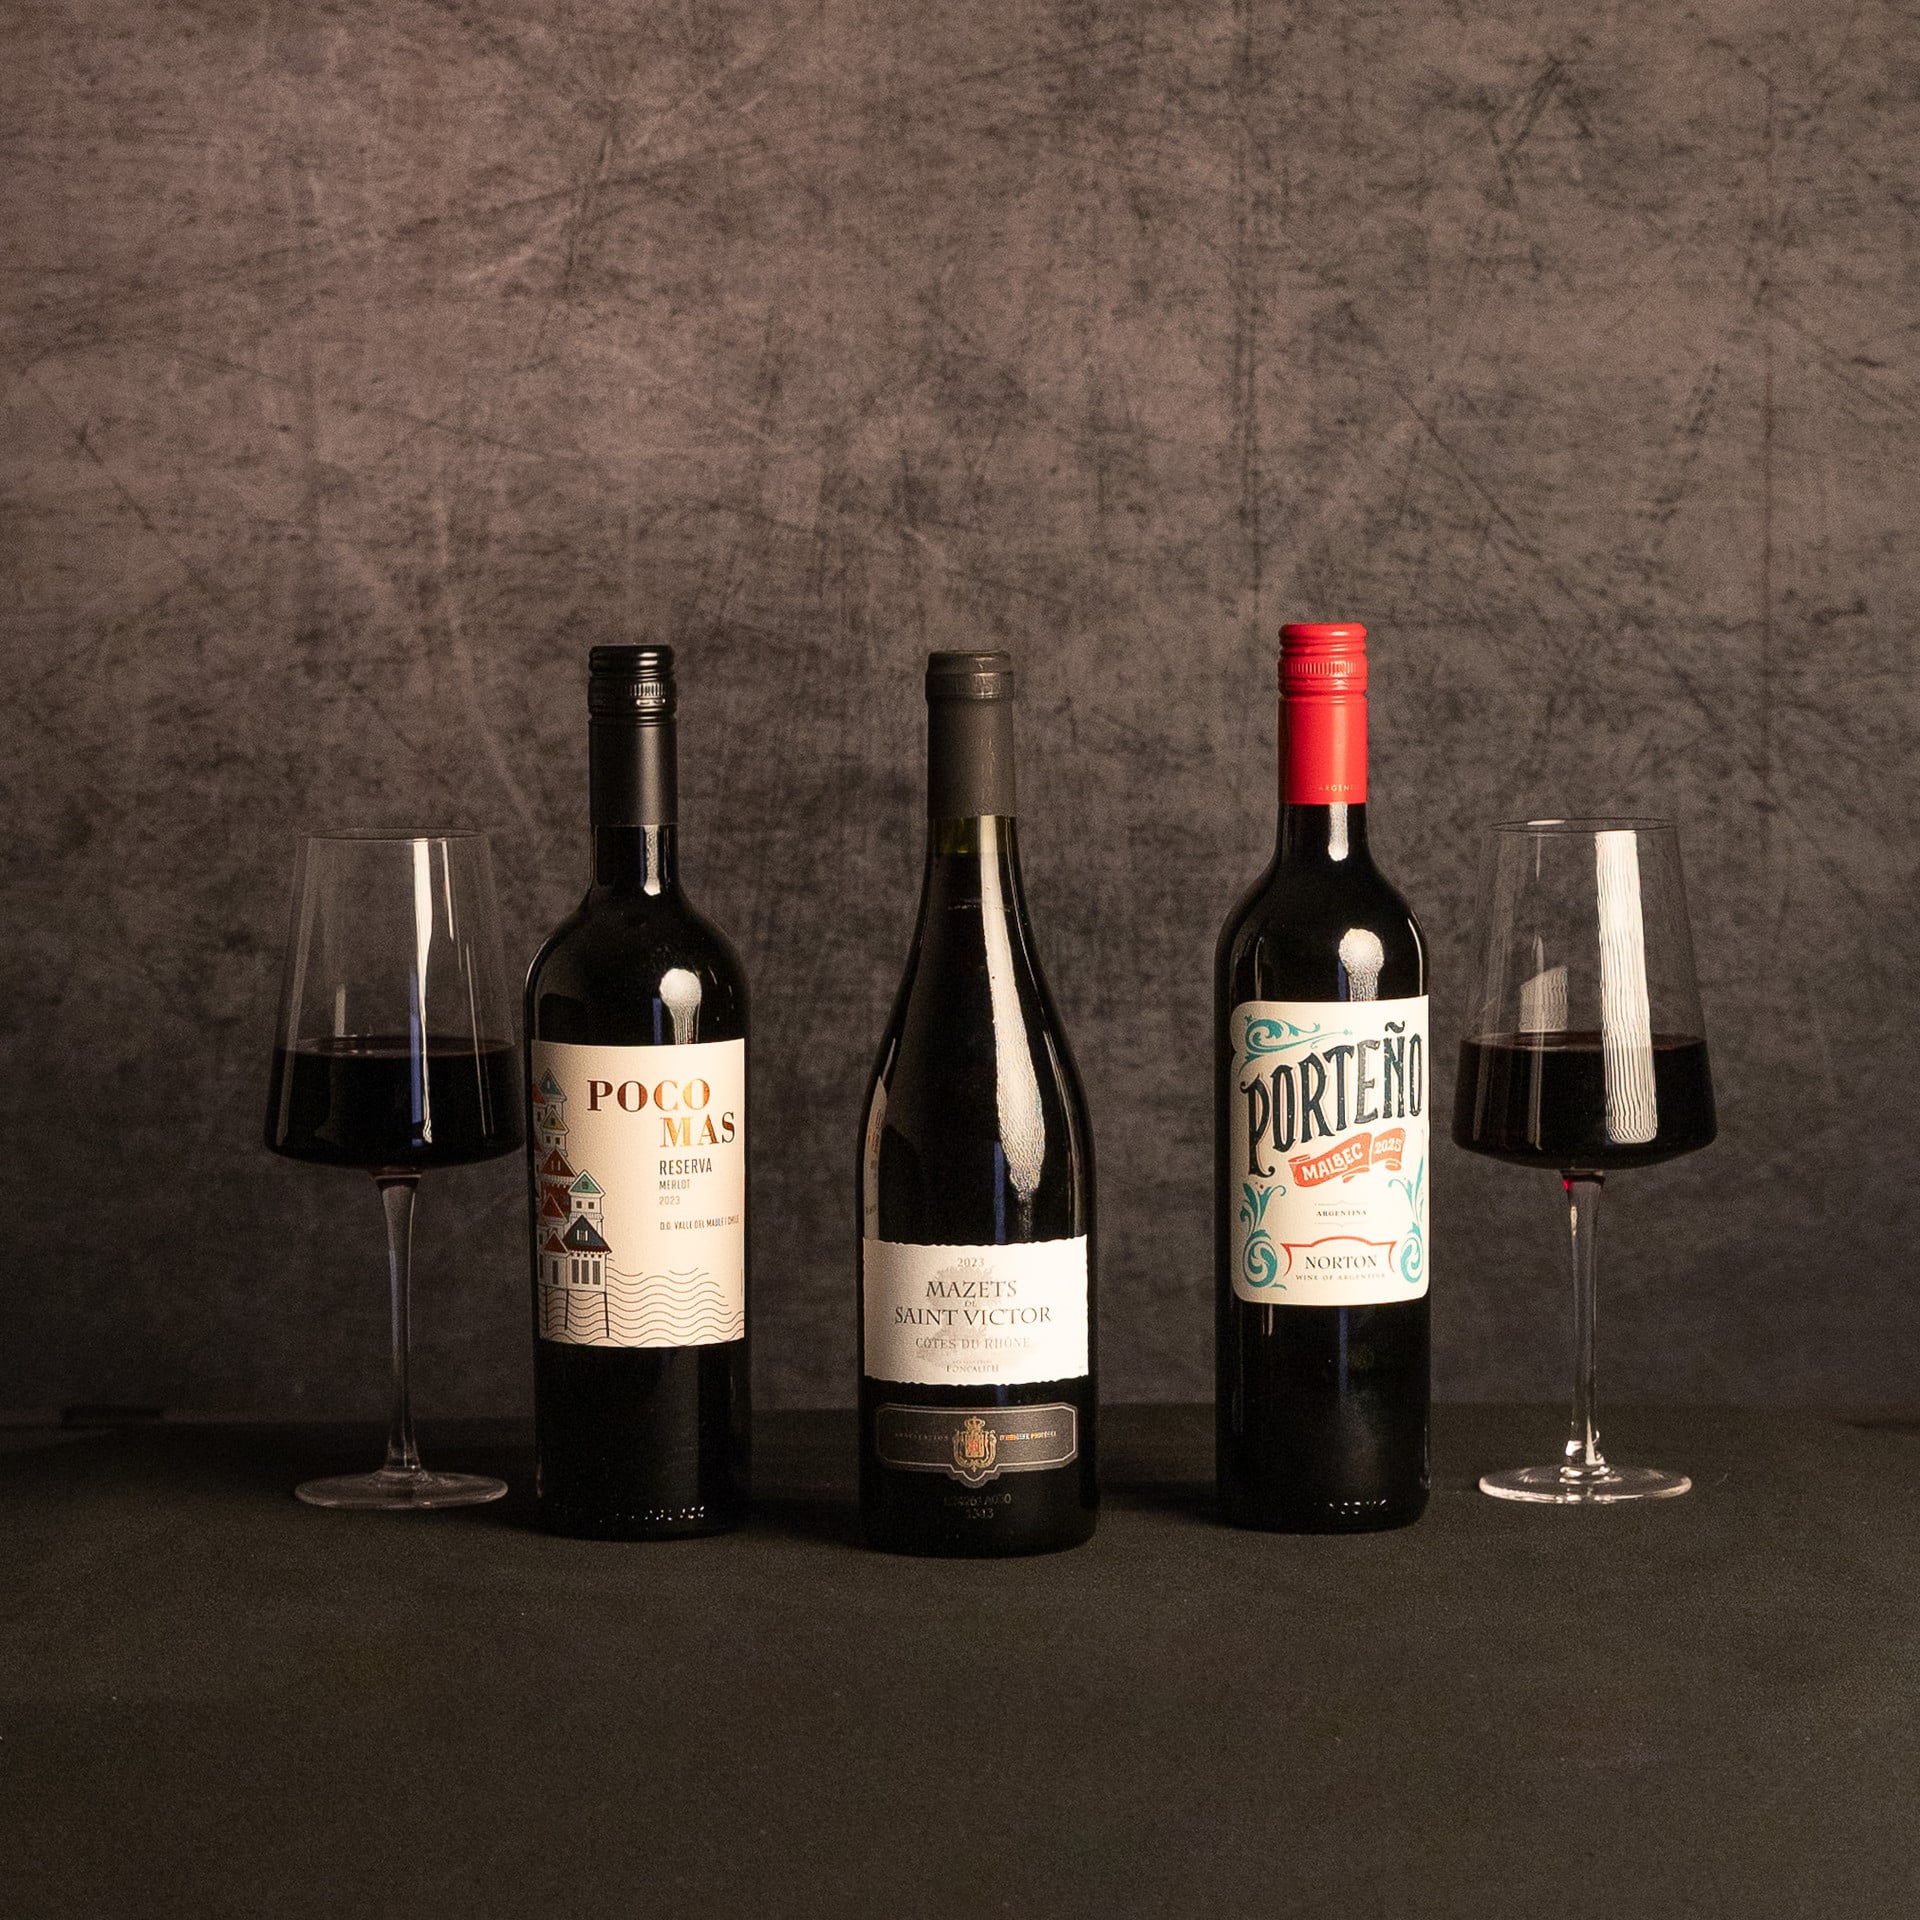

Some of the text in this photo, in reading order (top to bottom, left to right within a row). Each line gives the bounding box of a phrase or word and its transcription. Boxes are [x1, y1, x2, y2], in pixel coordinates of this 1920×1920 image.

[587, 1078, 711, 1113] POCO
[1240, 1020, 1422, 1178] PORTEÑO
[660, 1111, 736, 1148] MAS
[659, 1157, 713, 1176] RESERVA
[1301, 1142, 1364, 1182] MALBEC
[659, 1179, 691, 1191] MERLOT
[659, 1196, 681, 1206] 2023
[1316, 1209, 1368, 1218] ARGENTINA
[674, 1220, 693, 1230] VALLE
[694, 1220, 705, 1229] DEL
[957, 1257, 985, 1268] 2023
[1305, 1254, 1377, 1270] NORTON
[925, 1279, 1018, 1299] MAZETS
[894, 1306, 1052, 1327] SAINT VICTOR
[961, 1338, 979, 1350] DU
